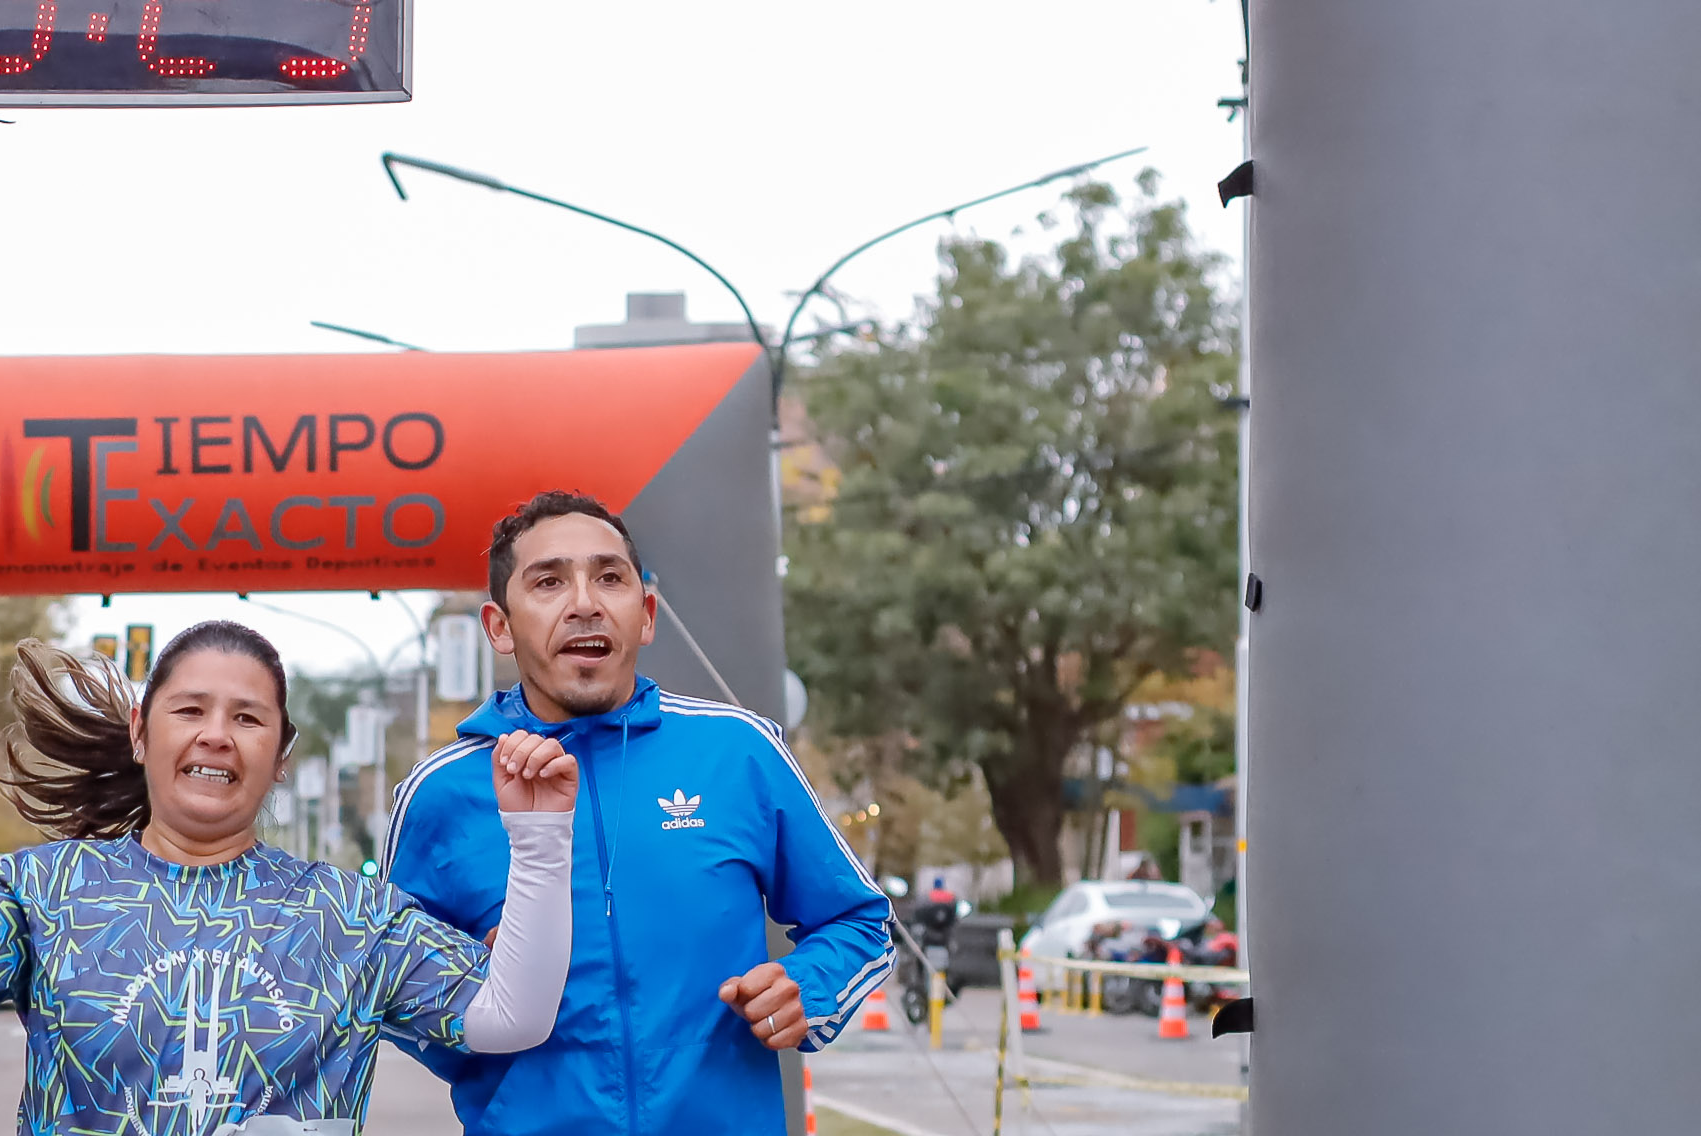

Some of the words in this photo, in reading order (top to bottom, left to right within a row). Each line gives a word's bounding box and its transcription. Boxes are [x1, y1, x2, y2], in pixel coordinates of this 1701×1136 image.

[96, 441, 446, 553] EXACTO
[152, 559, 184, 573] de
[198, 558, 293, 572] Eventos
[306, 557, 436, 573] Deportivos
[661, 817, 705, 830] adidas
[212, 948, 231, 966] EL
[235, 956, 294, 1032] AUTISMO
